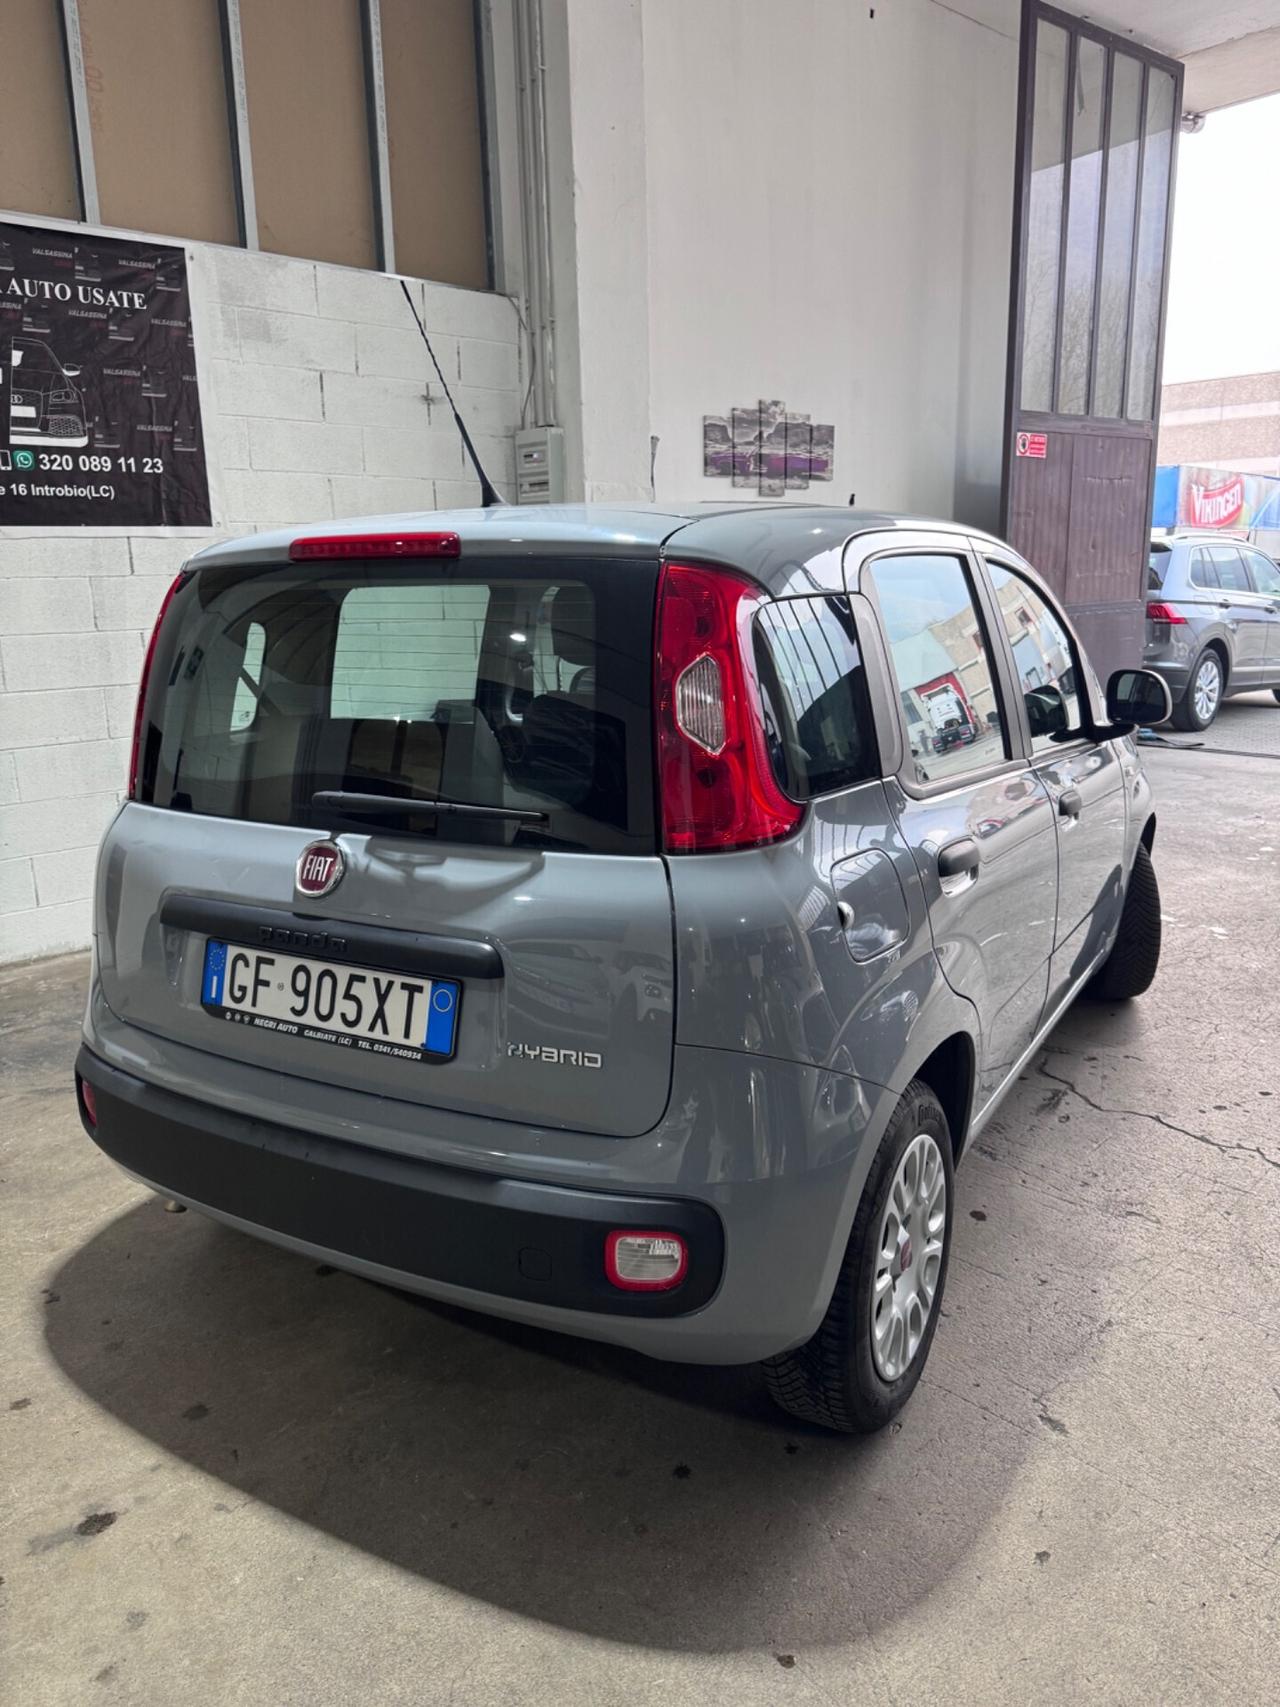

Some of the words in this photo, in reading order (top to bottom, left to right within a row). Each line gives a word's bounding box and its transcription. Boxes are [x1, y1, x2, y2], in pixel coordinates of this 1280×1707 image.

[6, 277, 72, 301] AUTO
[76, 285, 148, 310] USATE
[38, 454, 73, 471] 320
[78, 455, 112, 473] 089
[117, 457, 137, 473] 11
[142, 458, 164, 474] 23
[10, 484, 28, 497] 16
[31, 484, 115, 501] Introbio(LC)
[302, 855, 334, 882] FIAT
[254, 1017, 276, 1030] NEGRI
[277, 1023, 299, 1035] AUTO
[337, 1035, 354, 1047] (LC)
[357, 1040, 372, 1051] TEL.
[507, 1041, 603, 1069] HYBRID
